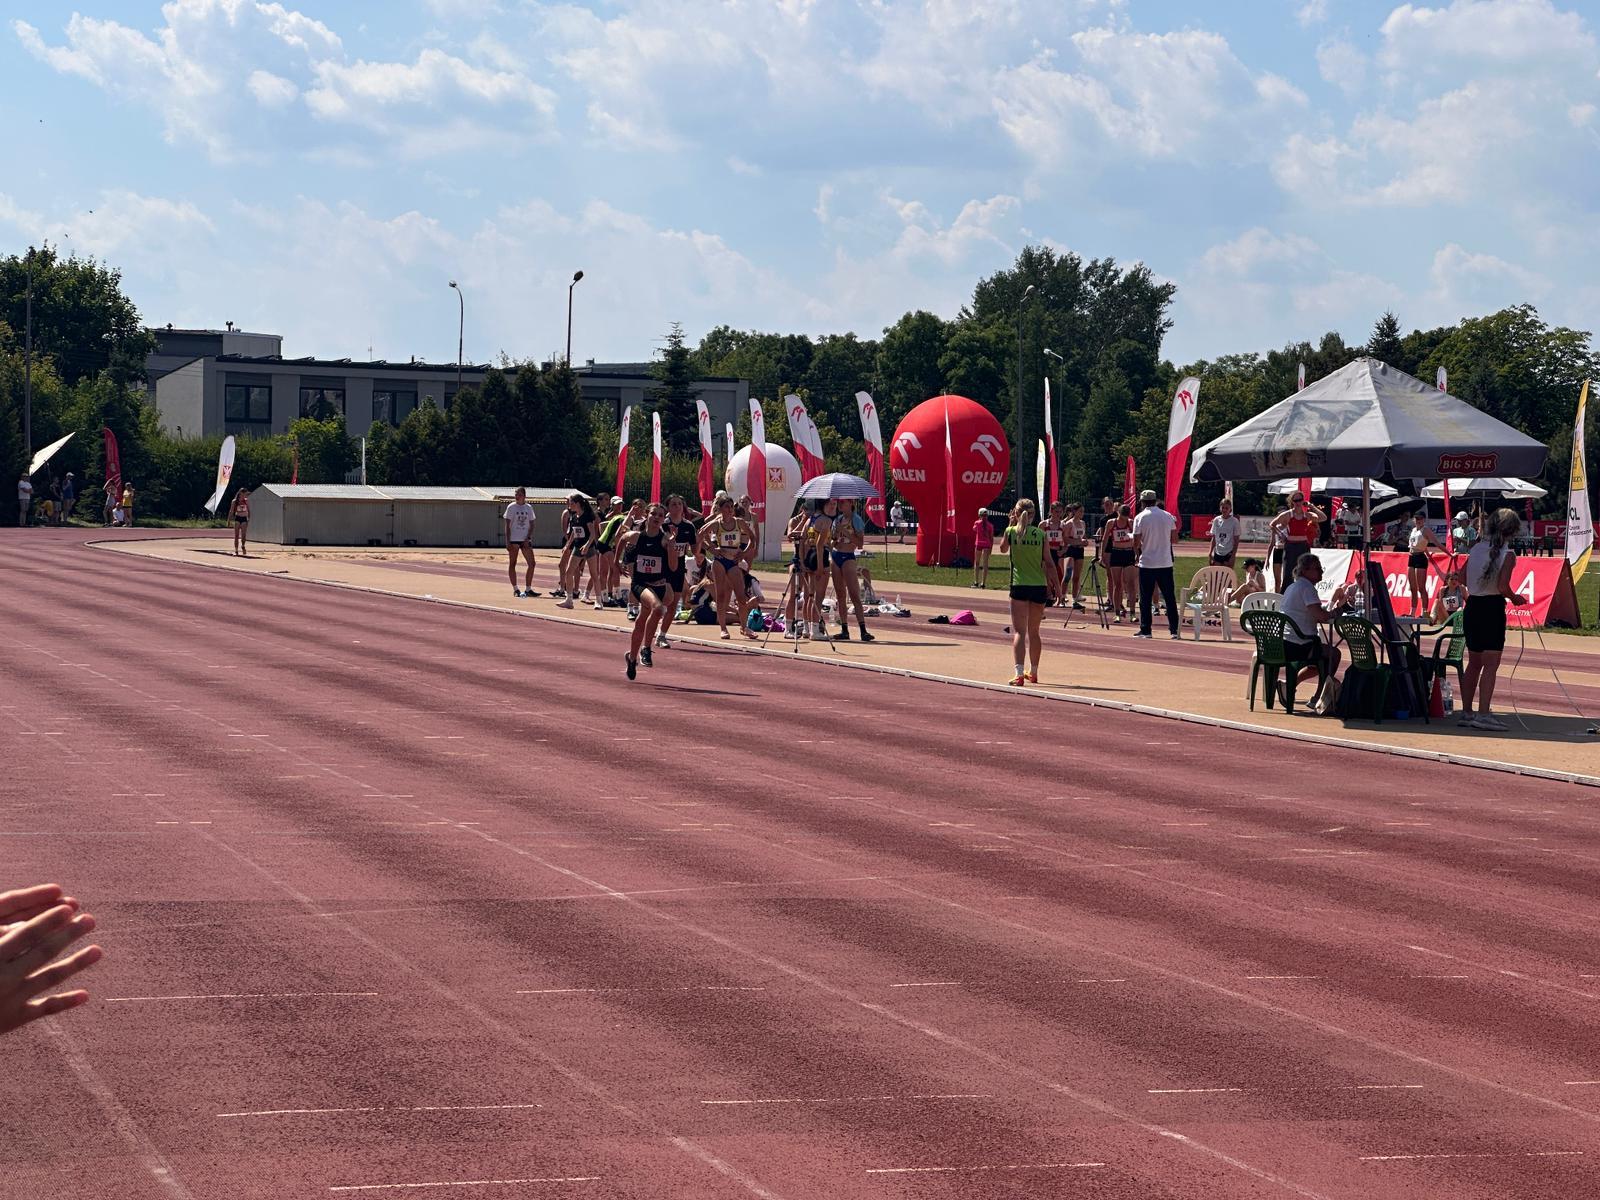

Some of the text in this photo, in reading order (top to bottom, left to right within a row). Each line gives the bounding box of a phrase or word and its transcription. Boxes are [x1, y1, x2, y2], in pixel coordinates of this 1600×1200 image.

[1442, 460, 1492, 469] BIG STAR
[892, 468, 926, 482] ORLEN
[962, 470, 1004, 484] ORLEN
[641, 559, 656, 568] 730
[1385, 573, 1439, 598] ORLN
